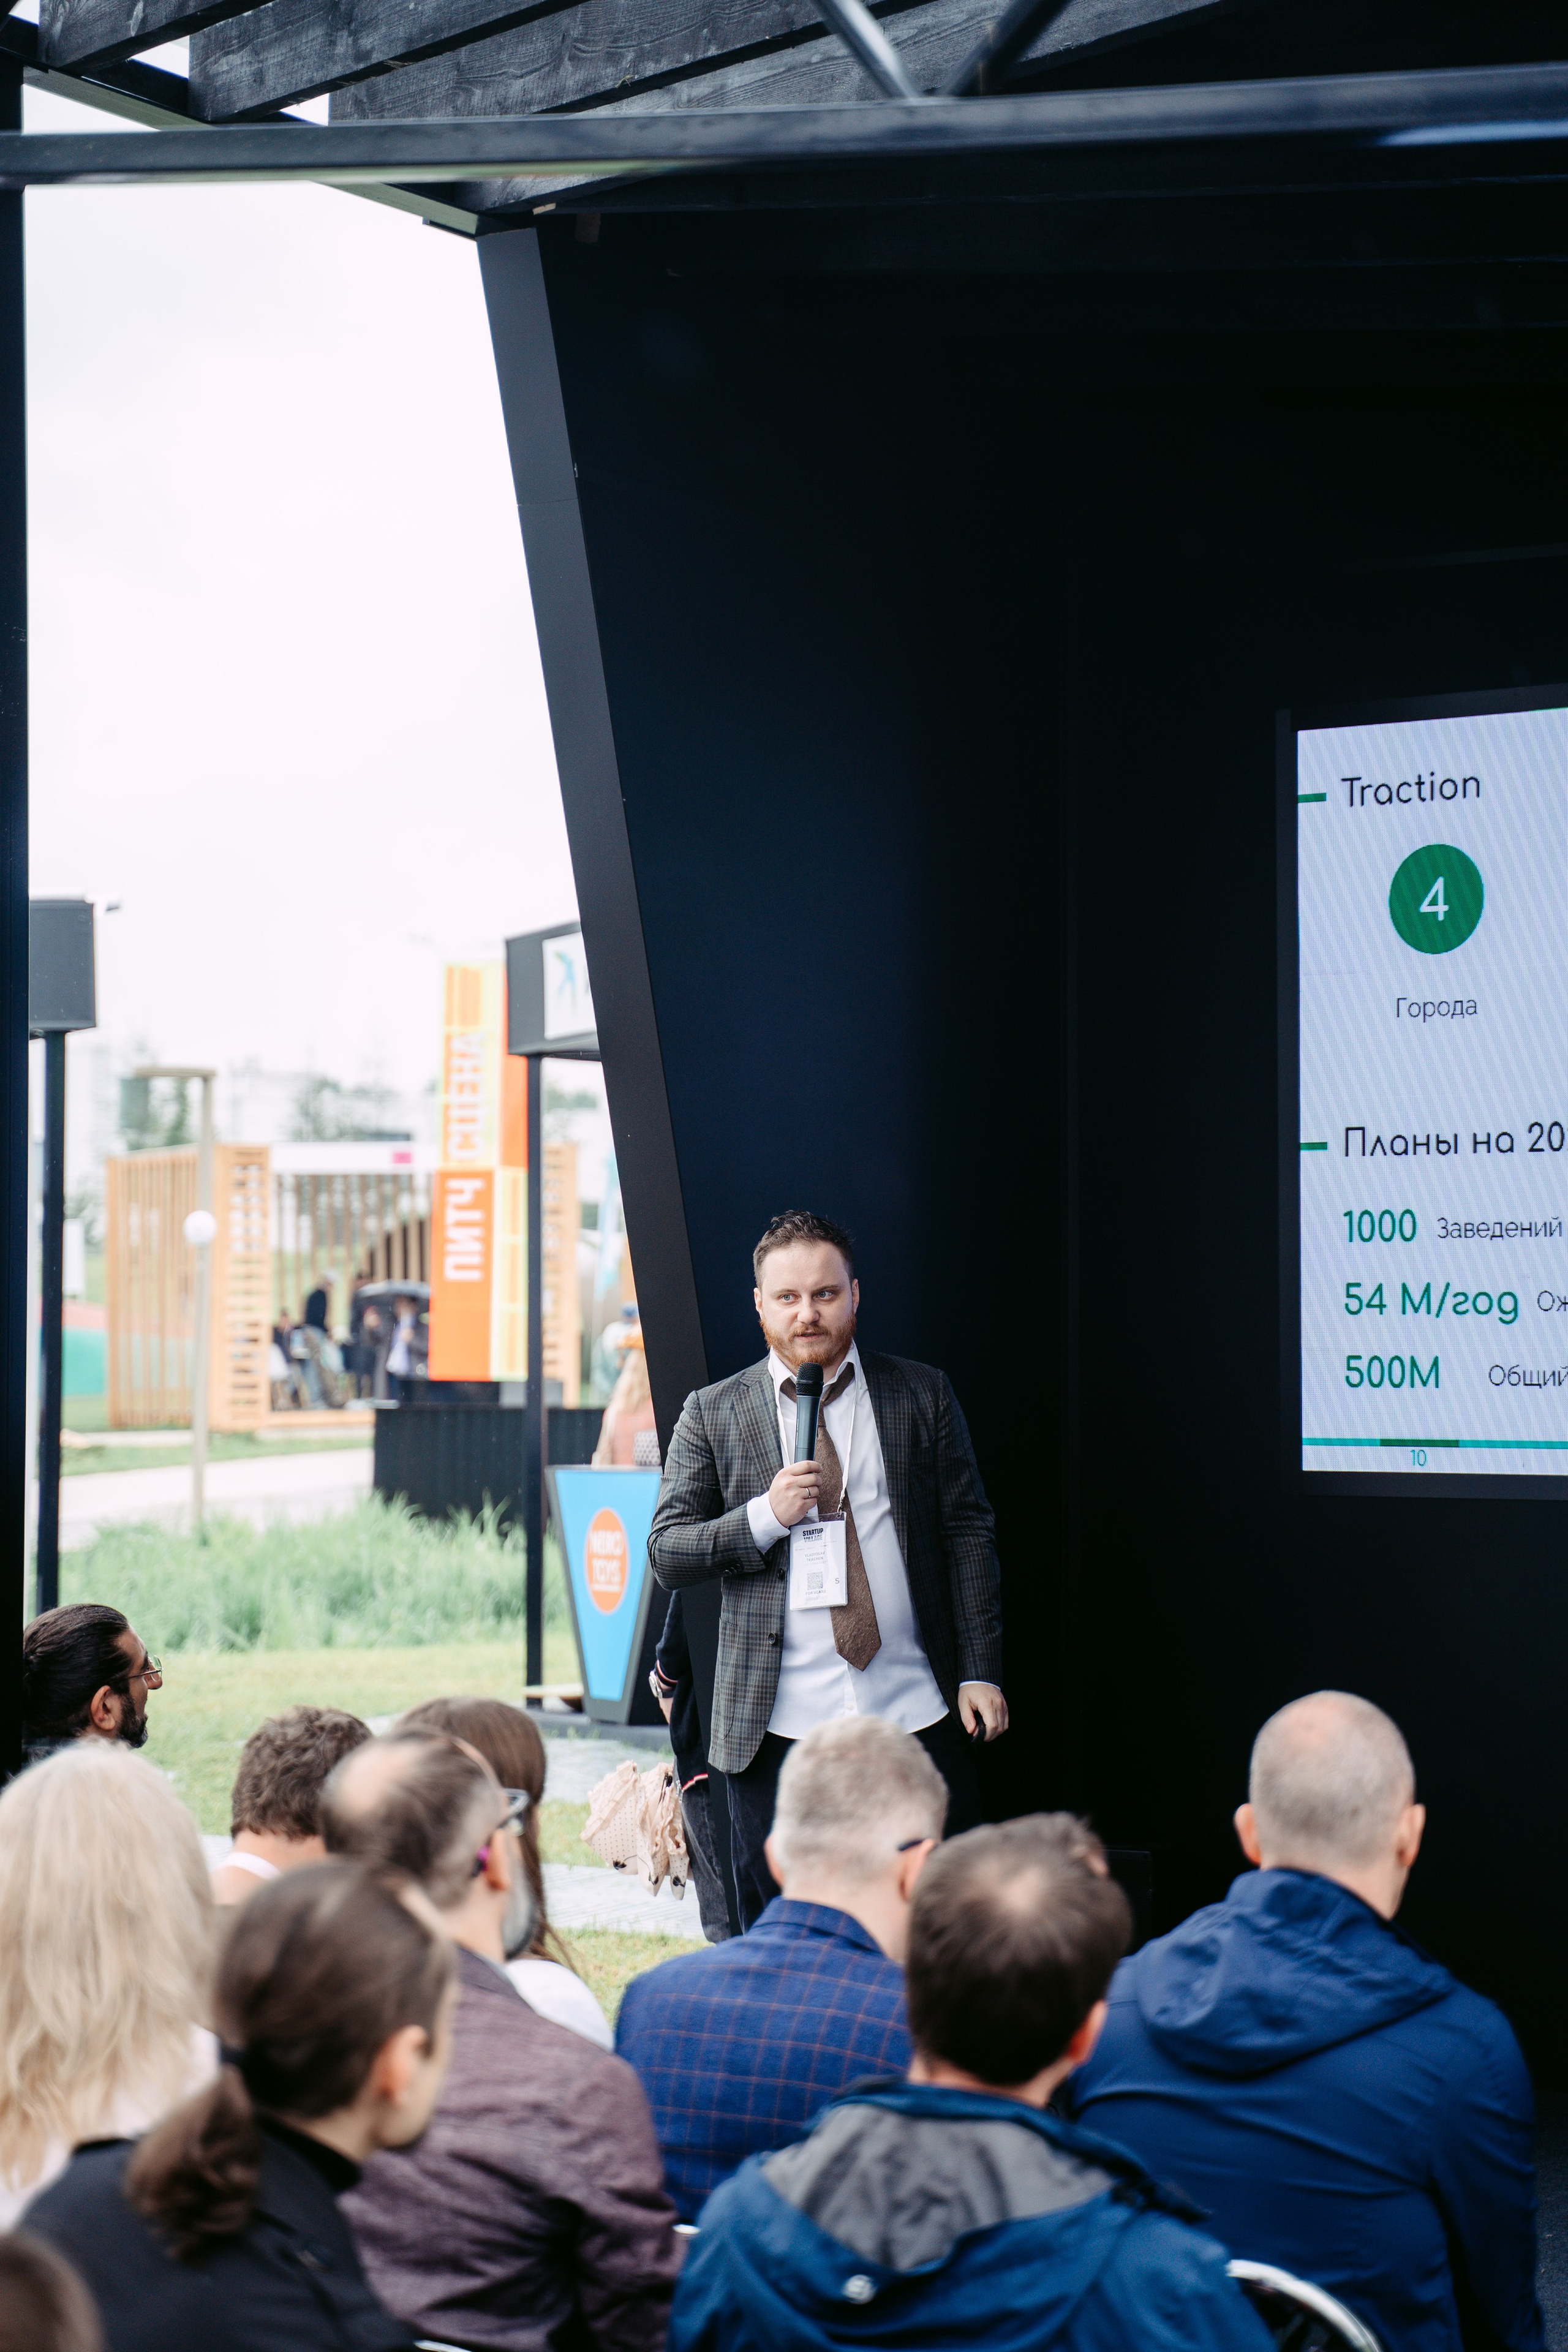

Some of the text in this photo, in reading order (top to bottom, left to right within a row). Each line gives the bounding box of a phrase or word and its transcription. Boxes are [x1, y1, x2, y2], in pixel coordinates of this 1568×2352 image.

[1341, 771, 1480, 807] Traction
[1419, 876, 1449, 921] 4
[1396, 997, 1478, 1023] Города
[1344, 1126, 1458, 1157] Планы
[1472, 1131, 1514, 1154] на
[444, 1177, 485, 1281] ПИТЧ
[1343, 1208, 1562, 1243] 1000 Заведений
[1344, 1282, 1387, 1316] 54
[1344, 1355, 1568, 1389] 500М Общий
[1410, 1449, 1428, 1467] 10
[802, 1528, 824, 1537] STARTUP
[804, 1534, 823, 1543] VILLAGE
